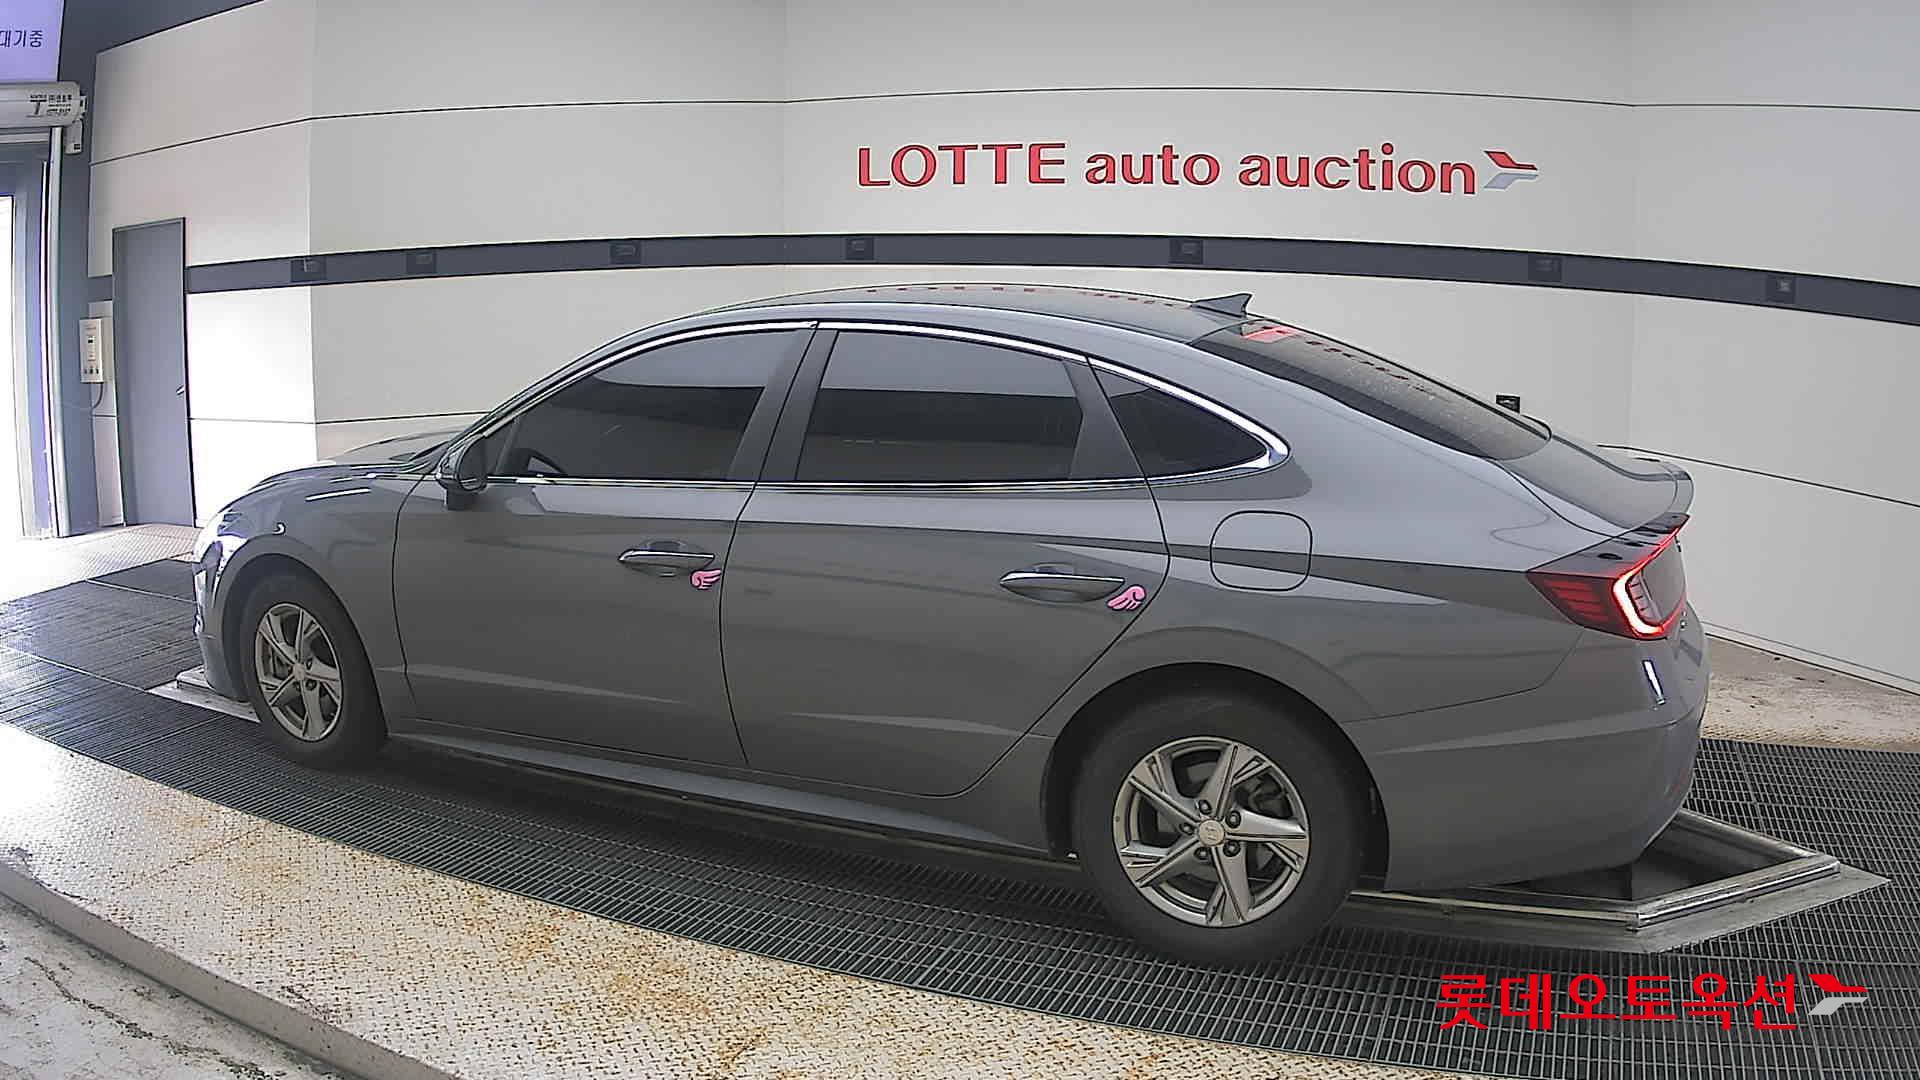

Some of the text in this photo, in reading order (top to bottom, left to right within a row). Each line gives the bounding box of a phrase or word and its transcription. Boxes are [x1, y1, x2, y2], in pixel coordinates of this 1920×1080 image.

[858, 142, 1477, 195] LOTTE auto auction
